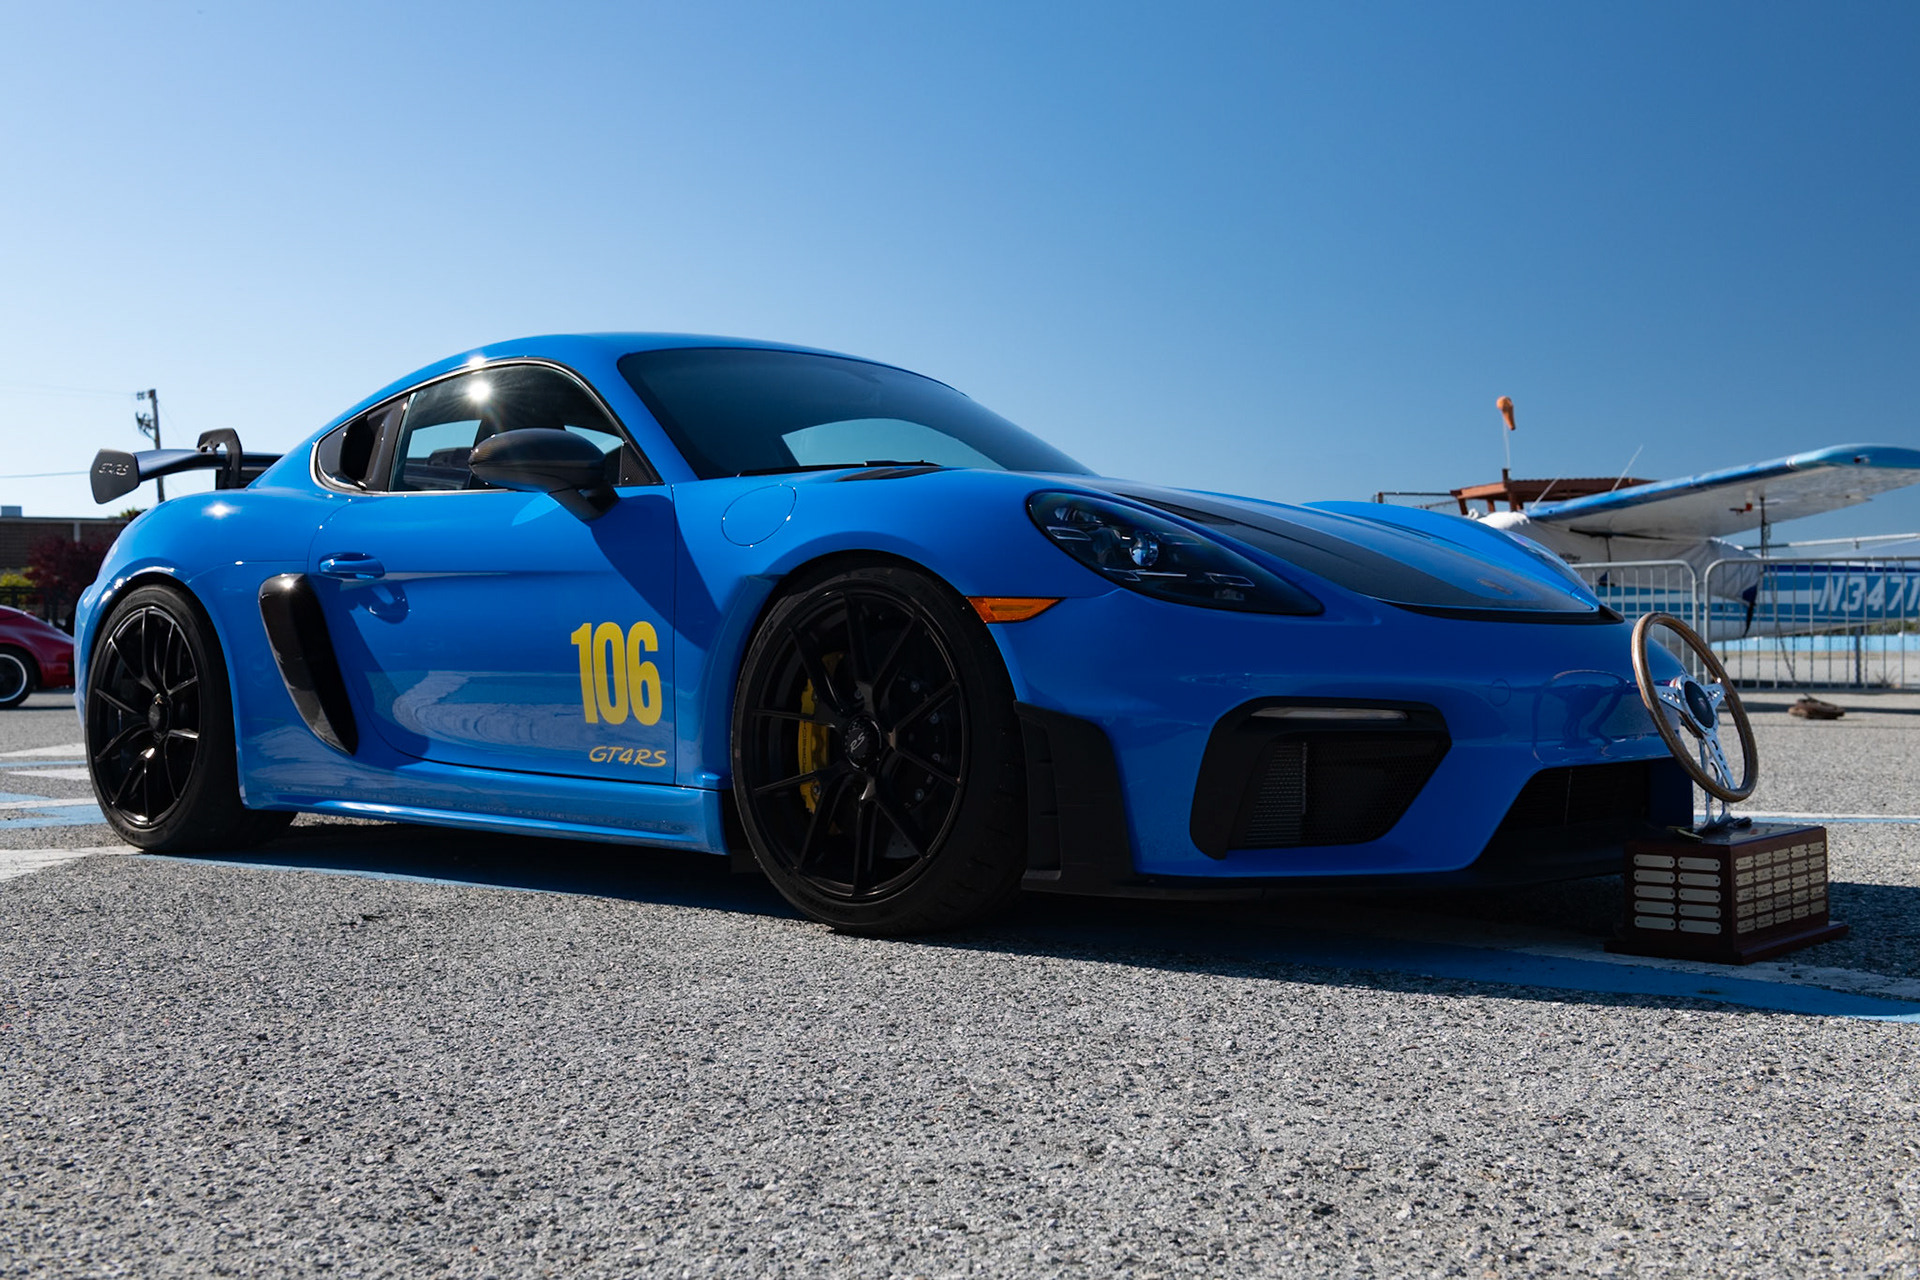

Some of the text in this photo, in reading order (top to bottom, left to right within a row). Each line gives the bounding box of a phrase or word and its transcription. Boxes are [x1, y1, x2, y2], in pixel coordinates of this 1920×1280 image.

[1818, 575, 1920, 612] N3471
[571, 621, 662, 726] 106
[589, 746, 667, 767] GT4RS
[850, 732, 866, 753] RS
